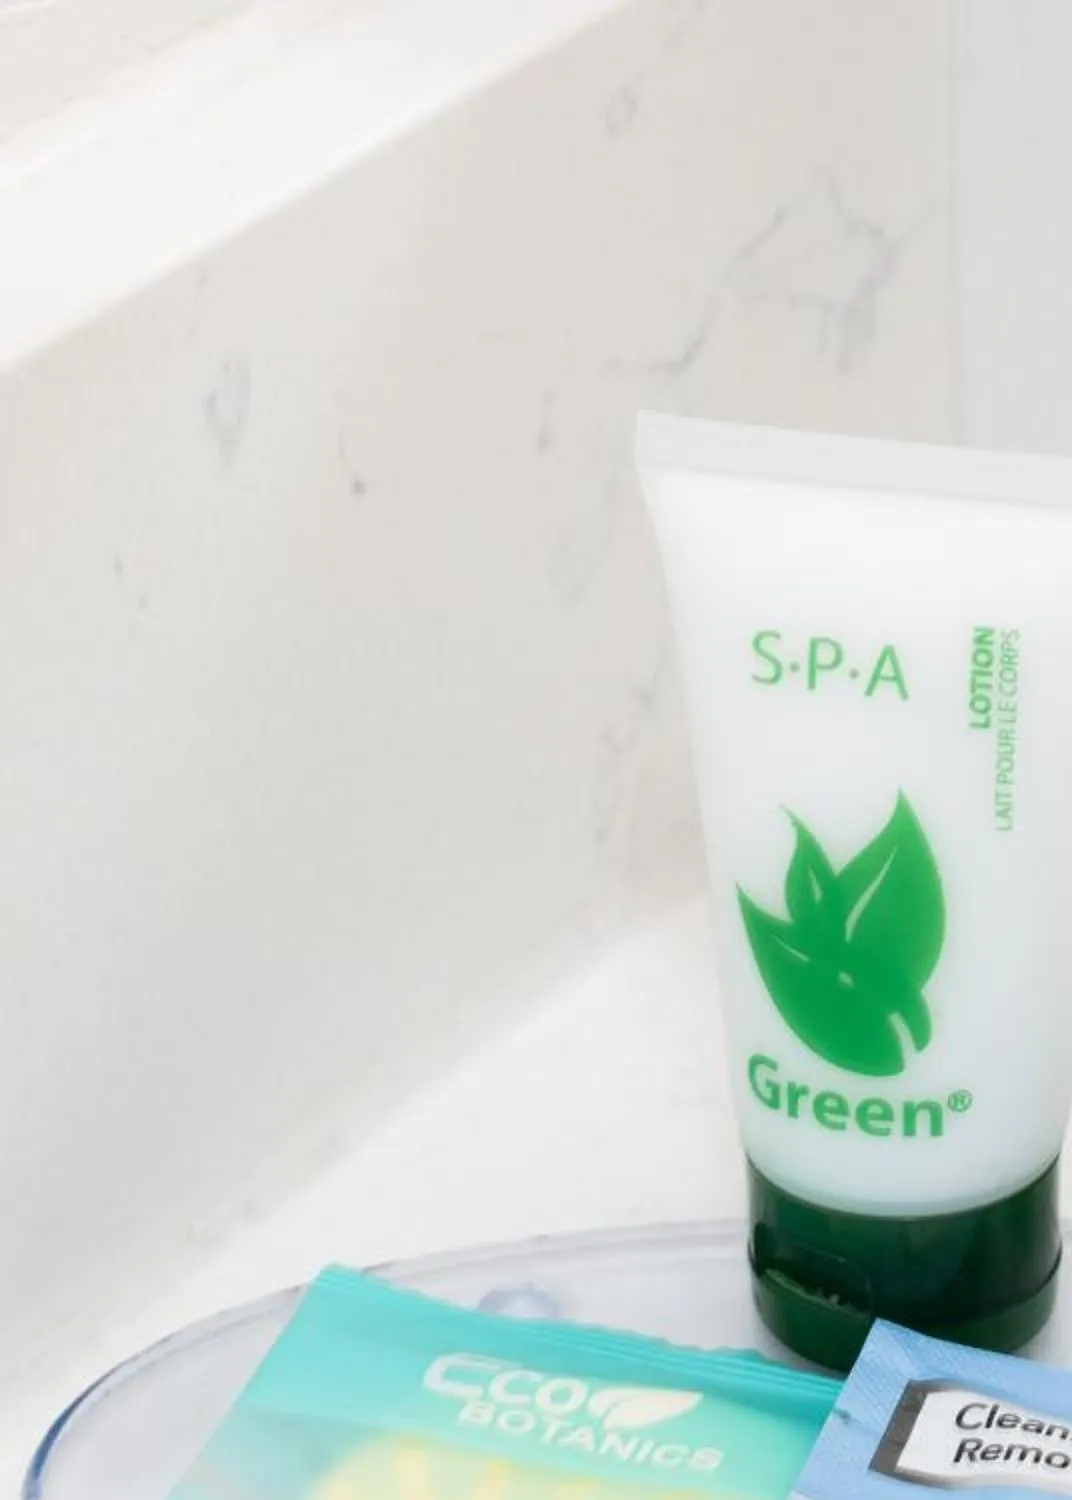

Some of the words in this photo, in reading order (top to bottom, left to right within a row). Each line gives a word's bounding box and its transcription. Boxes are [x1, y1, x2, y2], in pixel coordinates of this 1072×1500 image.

[968, 626, 995, 730] LOTION
[998, 627, 1021, 698] CORPS
[998, 701, 1017, 724] LE
[996, 728, 1016, 785] POUR
[995, 788, 1014, 832] LAIT
[457, 1398, 726, 1471] BOTANICS
